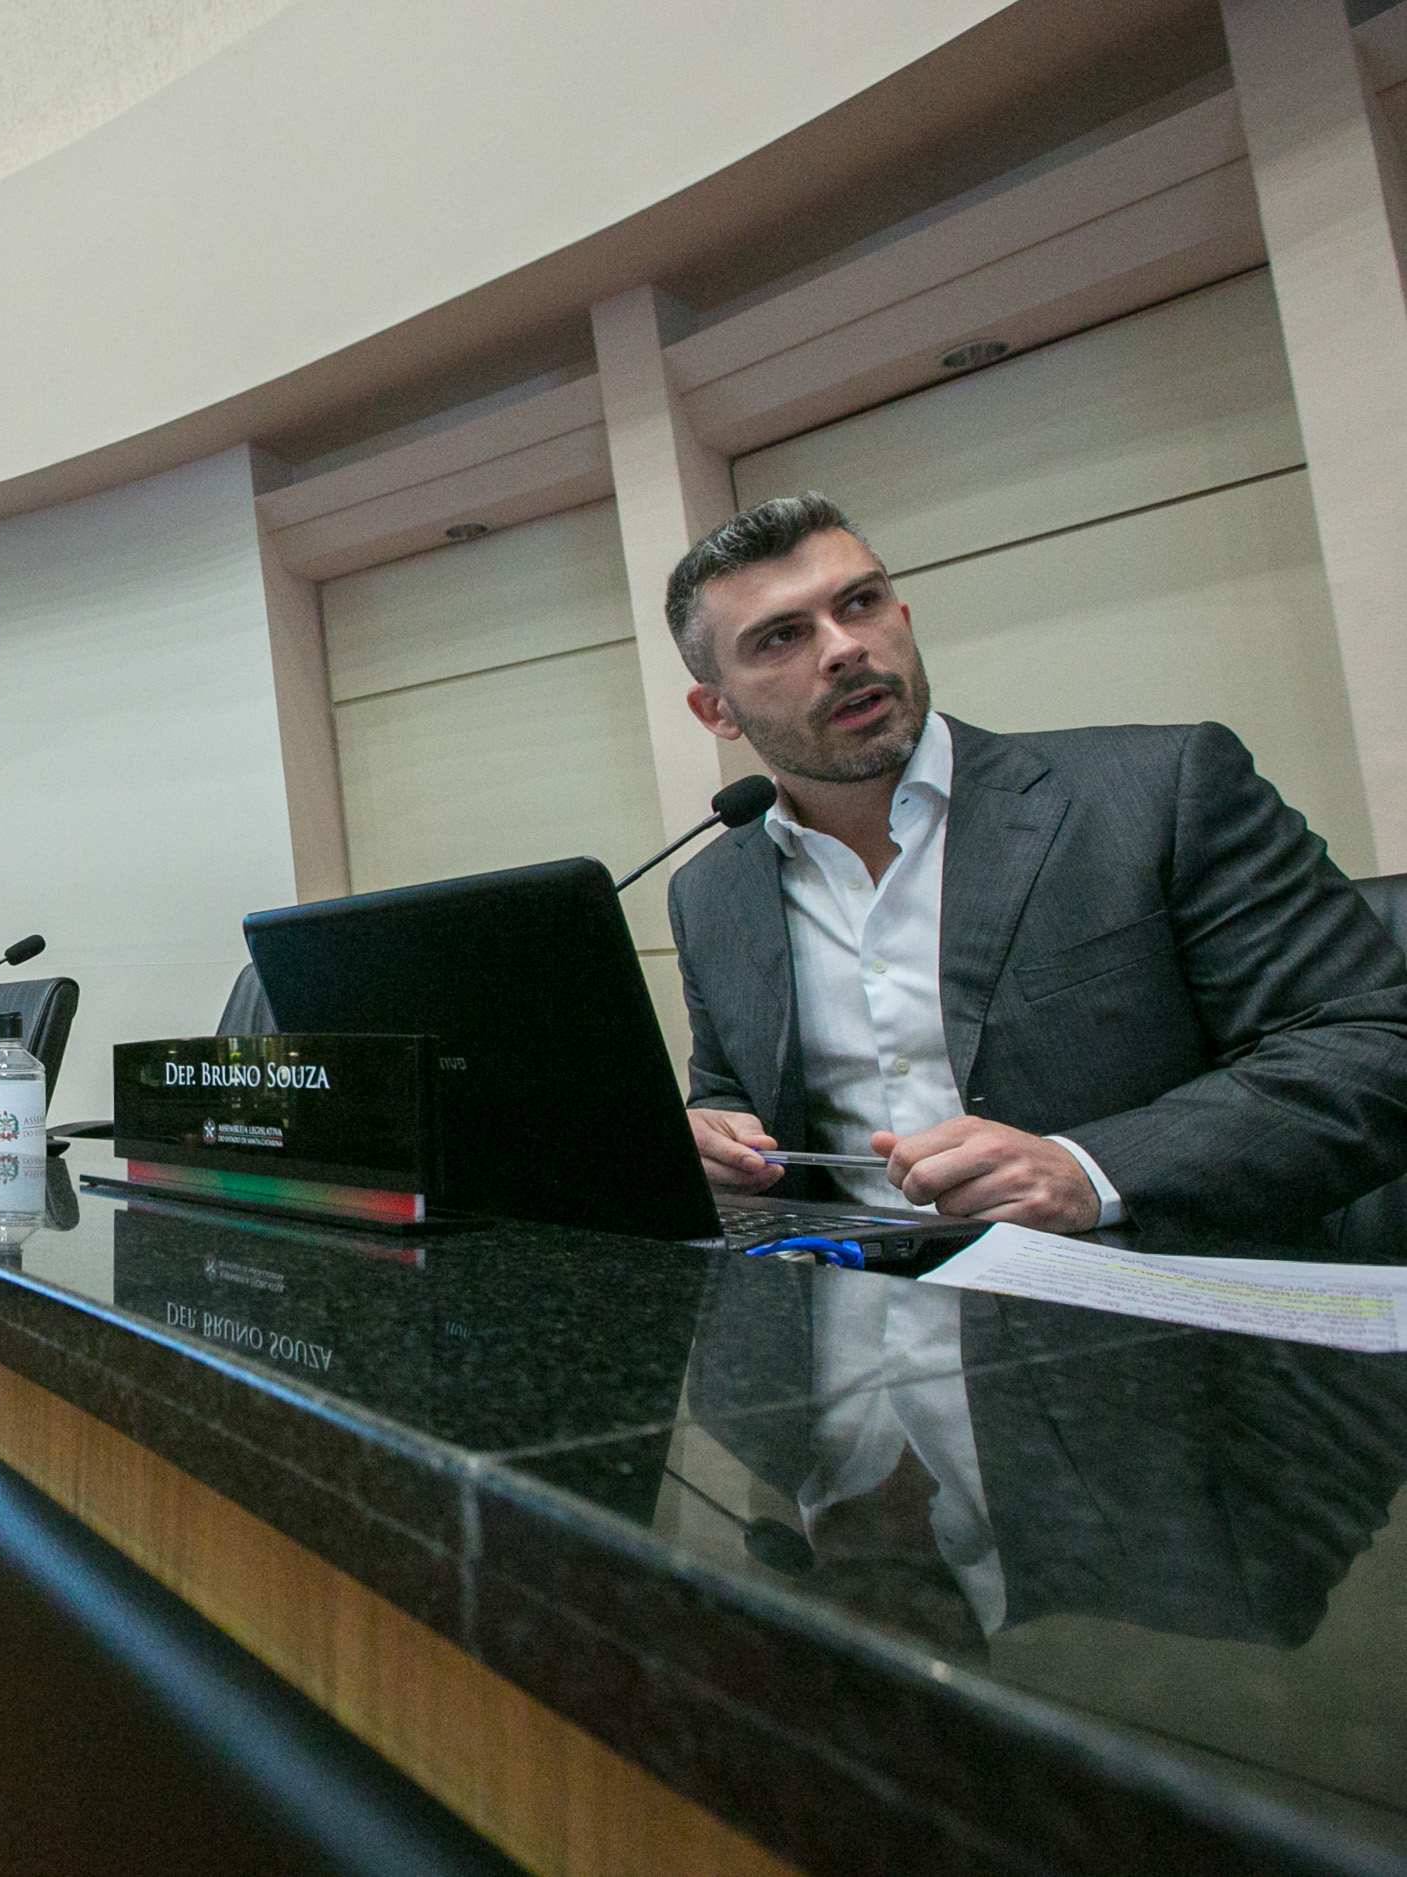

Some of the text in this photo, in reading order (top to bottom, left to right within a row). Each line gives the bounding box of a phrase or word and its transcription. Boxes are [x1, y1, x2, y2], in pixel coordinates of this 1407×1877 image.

[165, 1062, 331, 1089] DEP. BRUNO SOUZA
